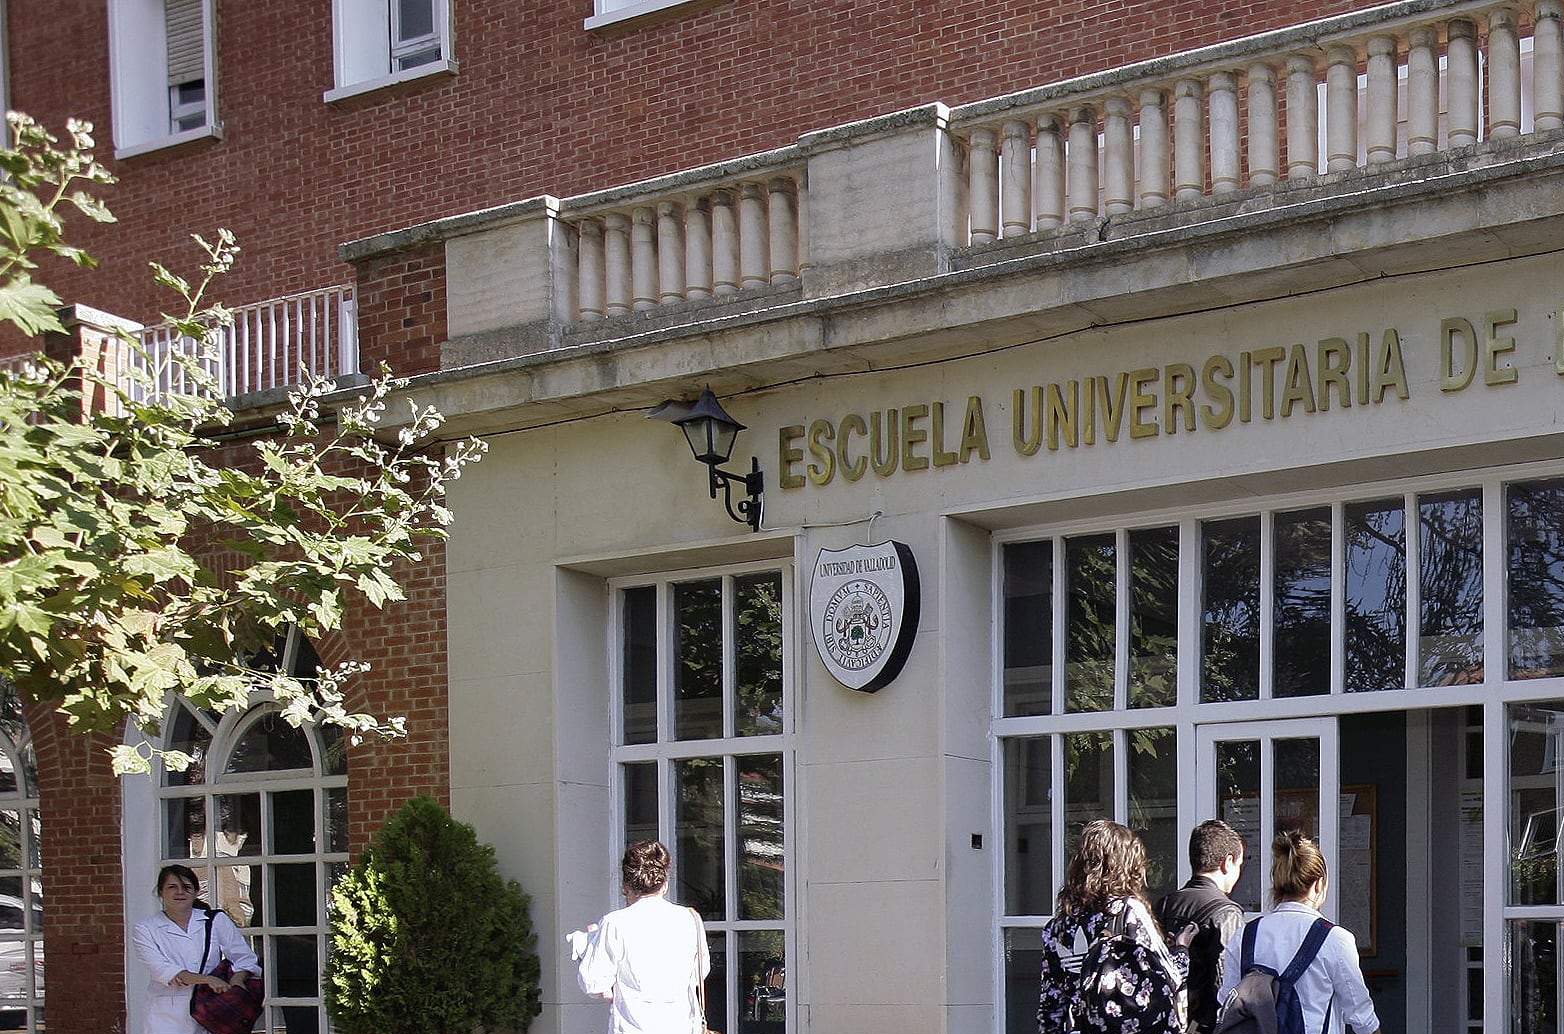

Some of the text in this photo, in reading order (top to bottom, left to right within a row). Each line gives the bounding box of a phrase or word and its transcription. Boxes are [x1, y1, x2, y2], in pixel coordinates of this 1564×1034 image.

[779, 395, 990, 489] ESCUELA
[1012, 326, 1410, 456] UNIVERSITARIA
[1440, 308, 1518, 392] DE
[819, 560, 855, 578] UNIVERSIDAD
[863, 556, 896, 573] VALLADOLID
